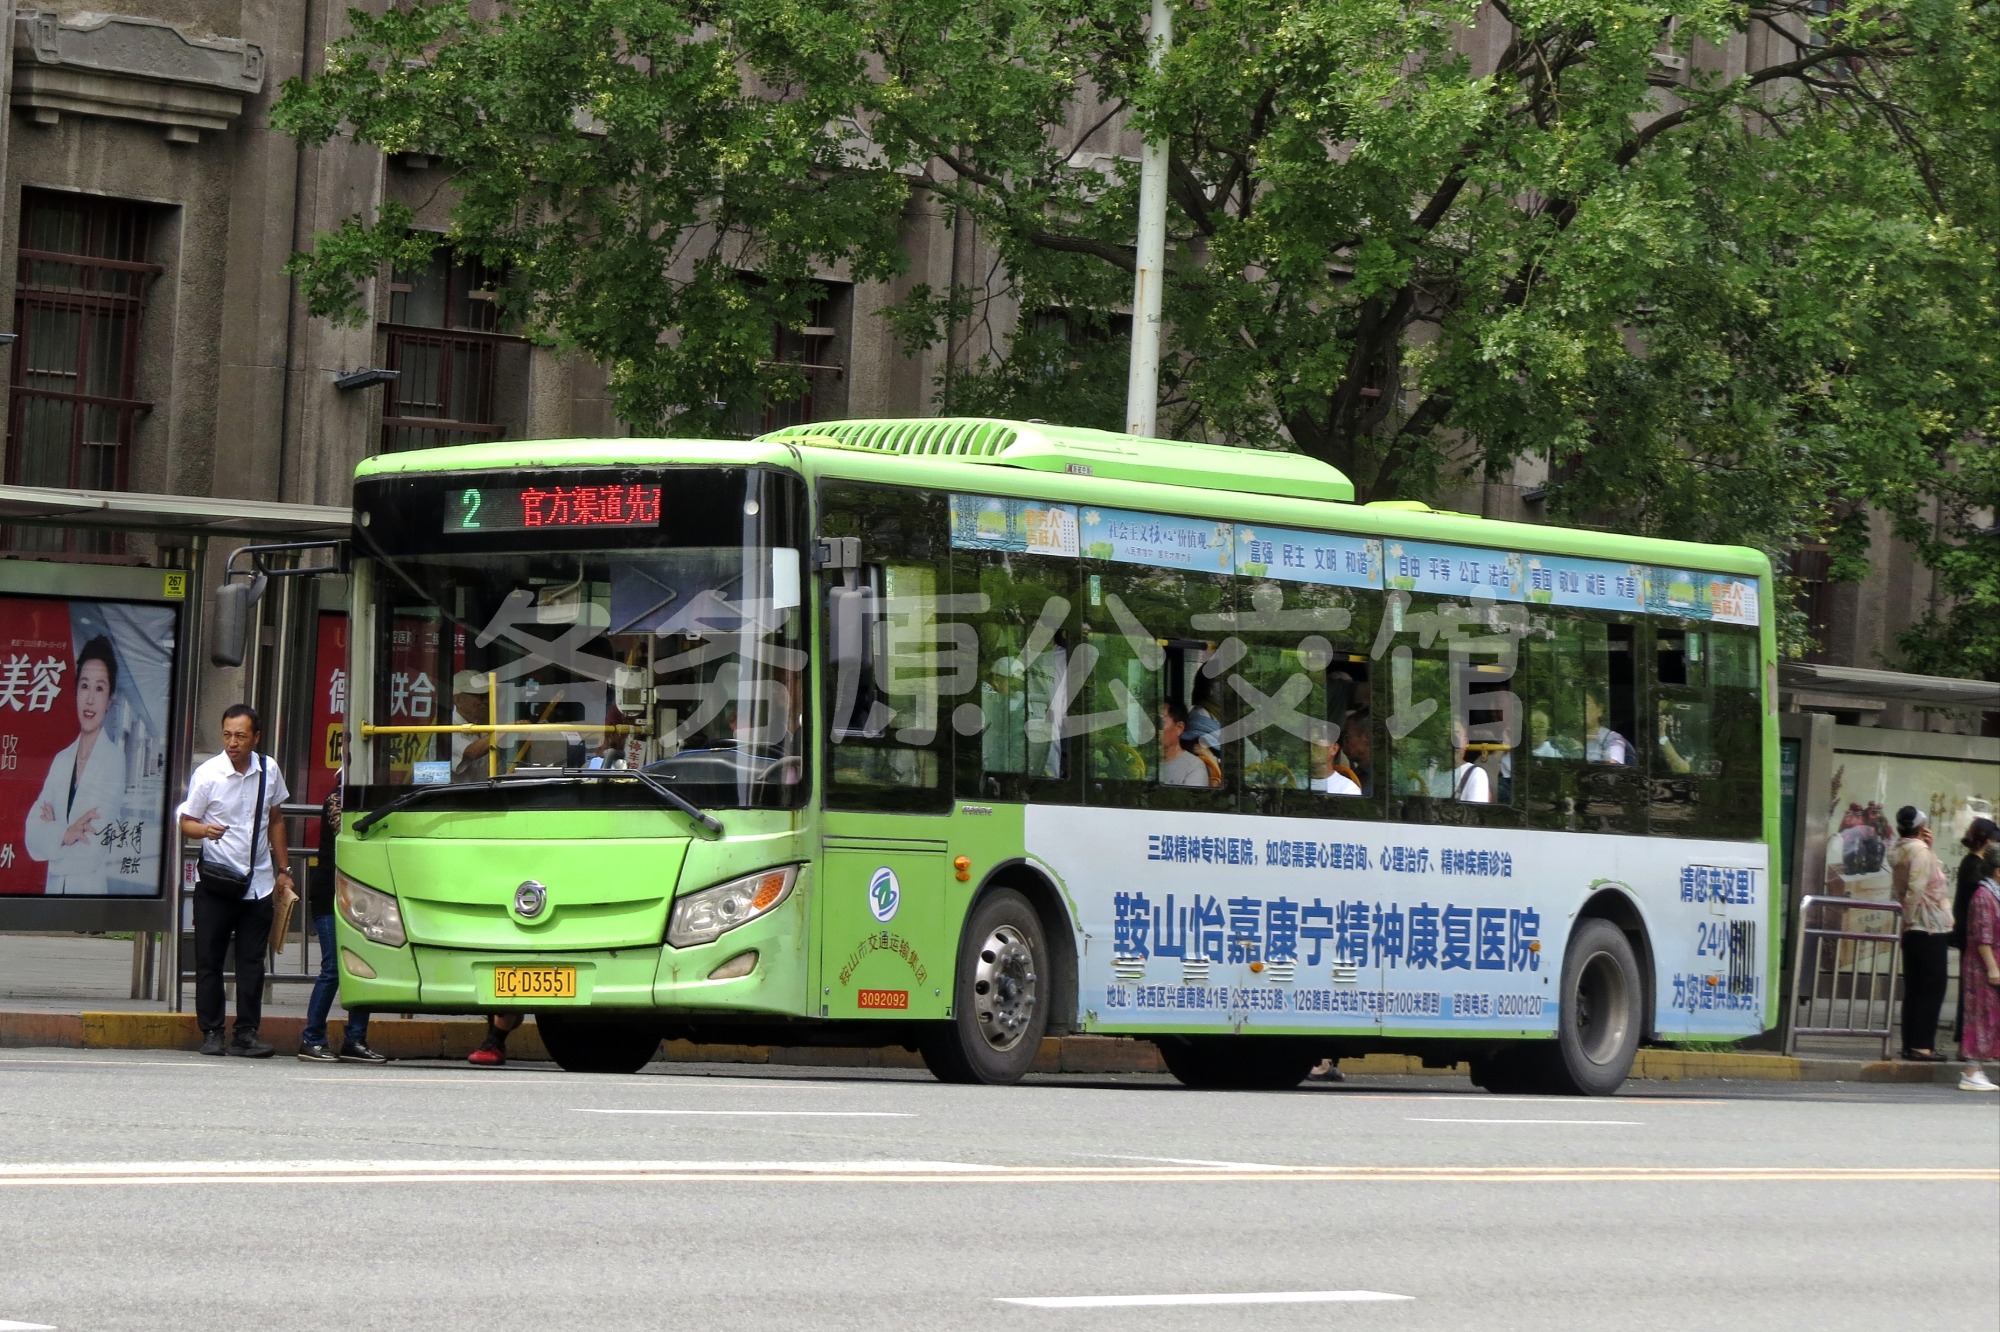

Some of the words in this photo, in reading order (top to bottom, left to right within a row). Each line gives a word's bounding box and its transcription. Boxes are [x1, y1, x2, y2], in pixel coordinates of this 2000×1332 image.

[463, 488, 481, 528] 2
[1109, 520, 1207, 549] 社会主义核心价值观
[1250, 539, 1274, 565] 富强
[1283, 543, 1306, 569] 民主
[1314, 547, 1337, 572] 文明
[1345, 550, 1368, 575] 和谐
[1399, 554, 1421, 579] 自由
[1429, 556, 1451, 582] 平等
[1459, 560, 1481, 585] 公正
[1488, 563, 1510, 588] 法治
[168, 575, 182, 587] 267
[1532, 567, 1553, 591] 爱国
[1559, 569, 1579, 594] 敬业
[1586, 571, 1606, 596] 诚信
[1615, 575, 1635, 599] 友善
[0, 653, 67, 714] 美容
[0, 843, 15, 869] 外
[120, 856, 140, 874] 院长
[1113, 891, 1541, 973] 鞍山怡嘉康宁精神康复医院
[838, 930, 928, 988] 鞍山市交通运输集团
[862, 992, 906, 1007] 3092092
